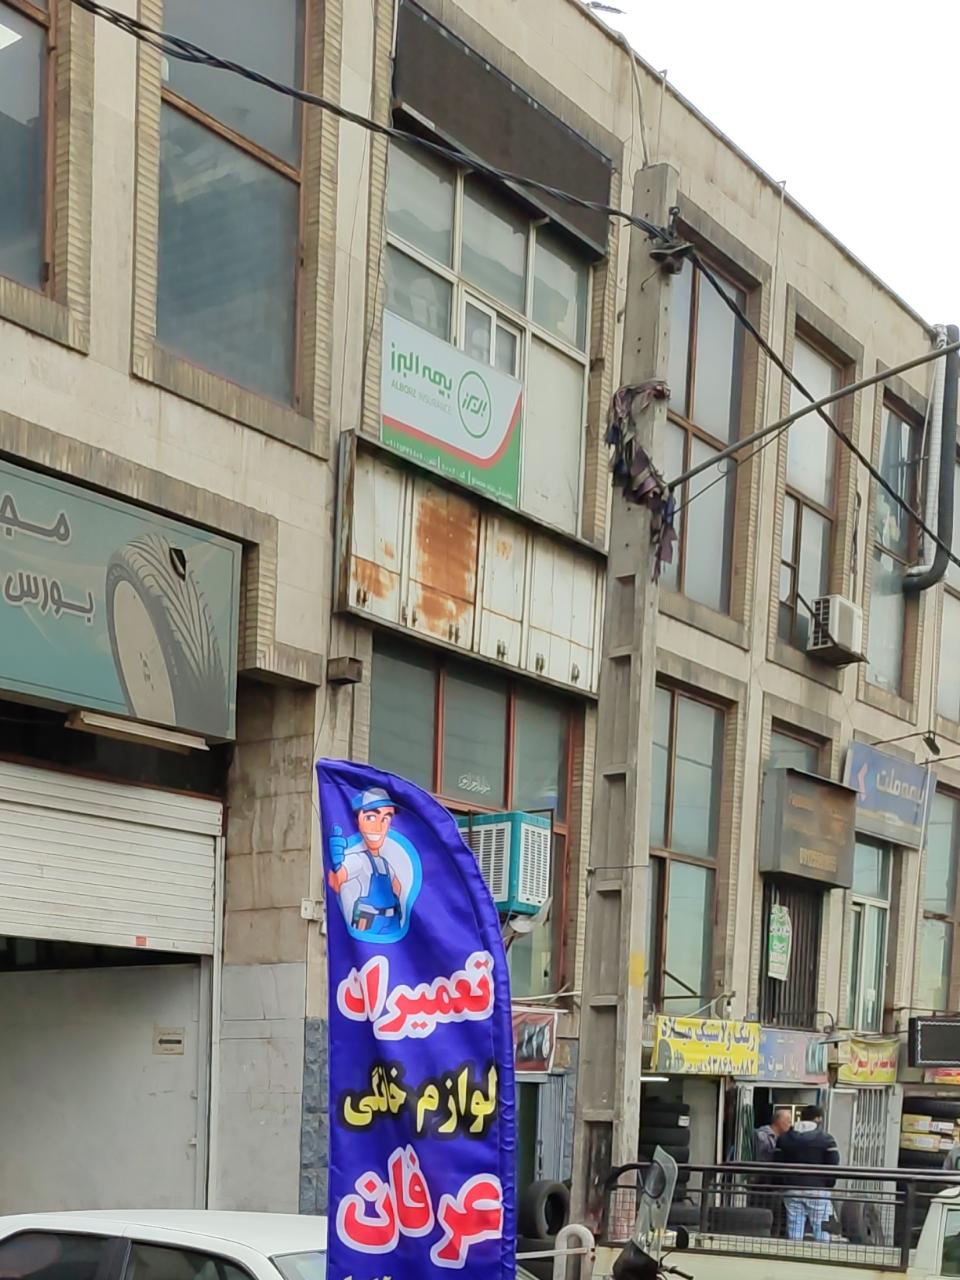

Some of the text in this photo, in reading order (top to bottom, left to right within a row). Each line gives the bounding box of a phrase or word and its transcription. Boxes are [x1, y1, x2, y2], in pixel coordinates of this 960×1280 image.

[390, 342, 452, 399] بیمه البرز
[6, 572, 94, 618] بورس
[417, 1065, 497, 1133] لوازم
[342, 1150, 503, 1262] عرفان
